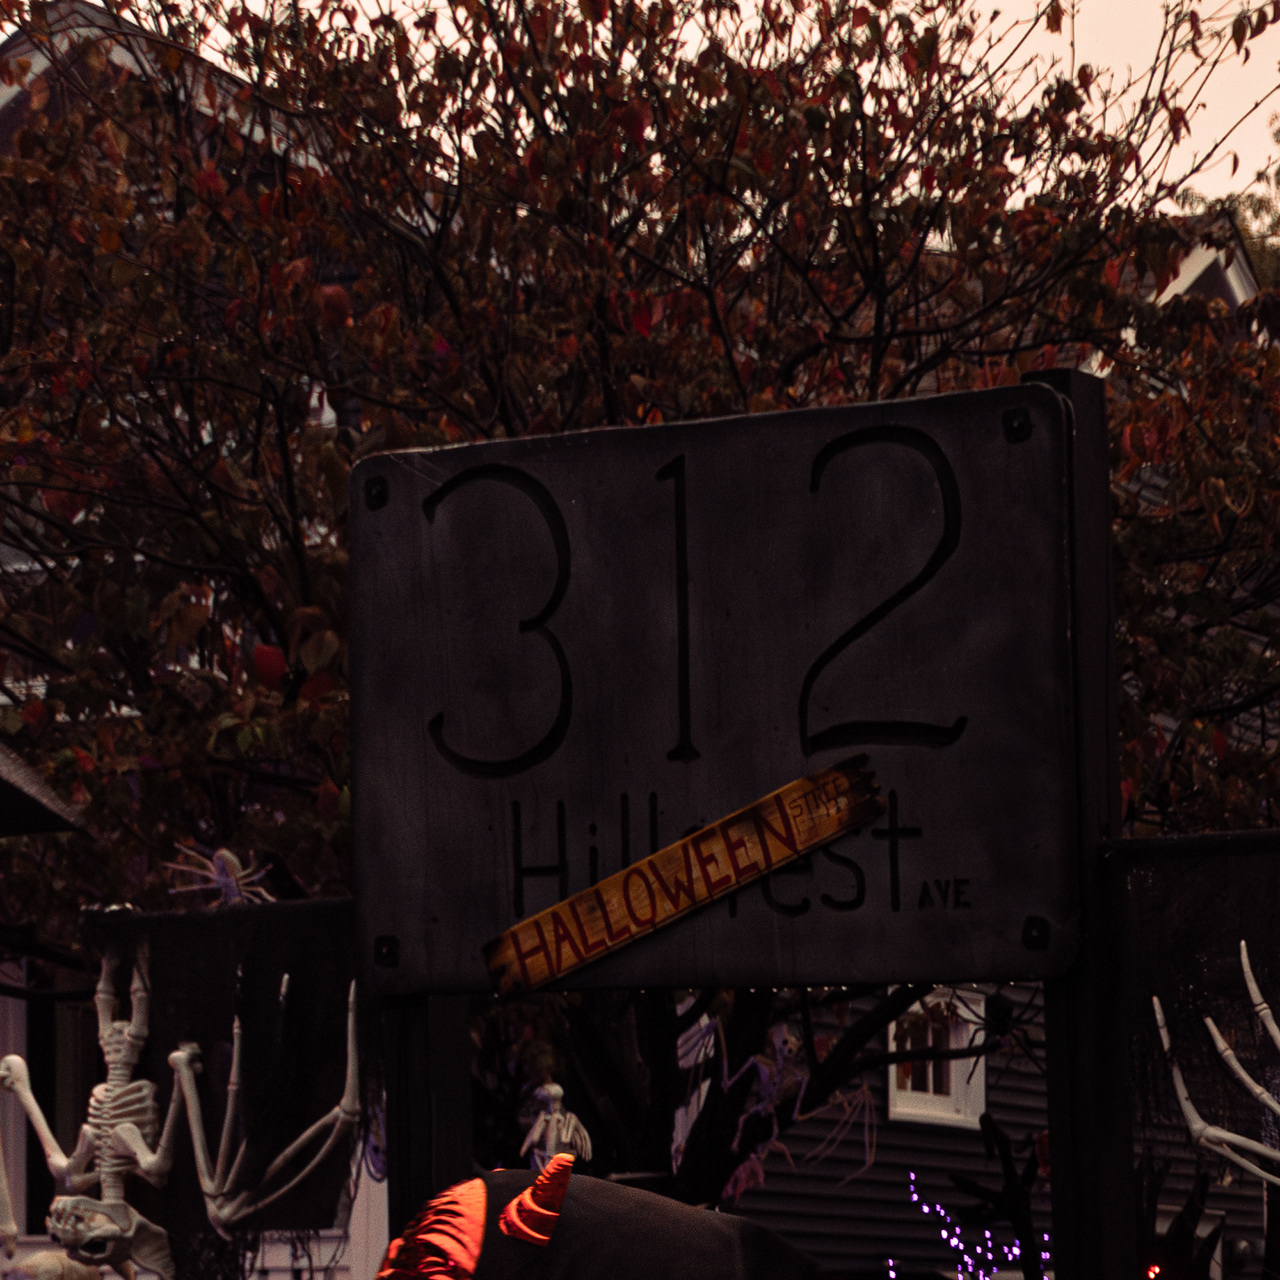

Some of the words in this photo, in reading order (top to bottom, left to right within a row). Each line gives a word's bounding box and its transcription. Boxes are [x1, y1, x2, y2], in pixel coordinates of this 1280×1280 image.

[422, 423, 968, 779] 312
[511, 793, 798, 991] HALLOWEEN
[918, 879, 972, 910] AVE
